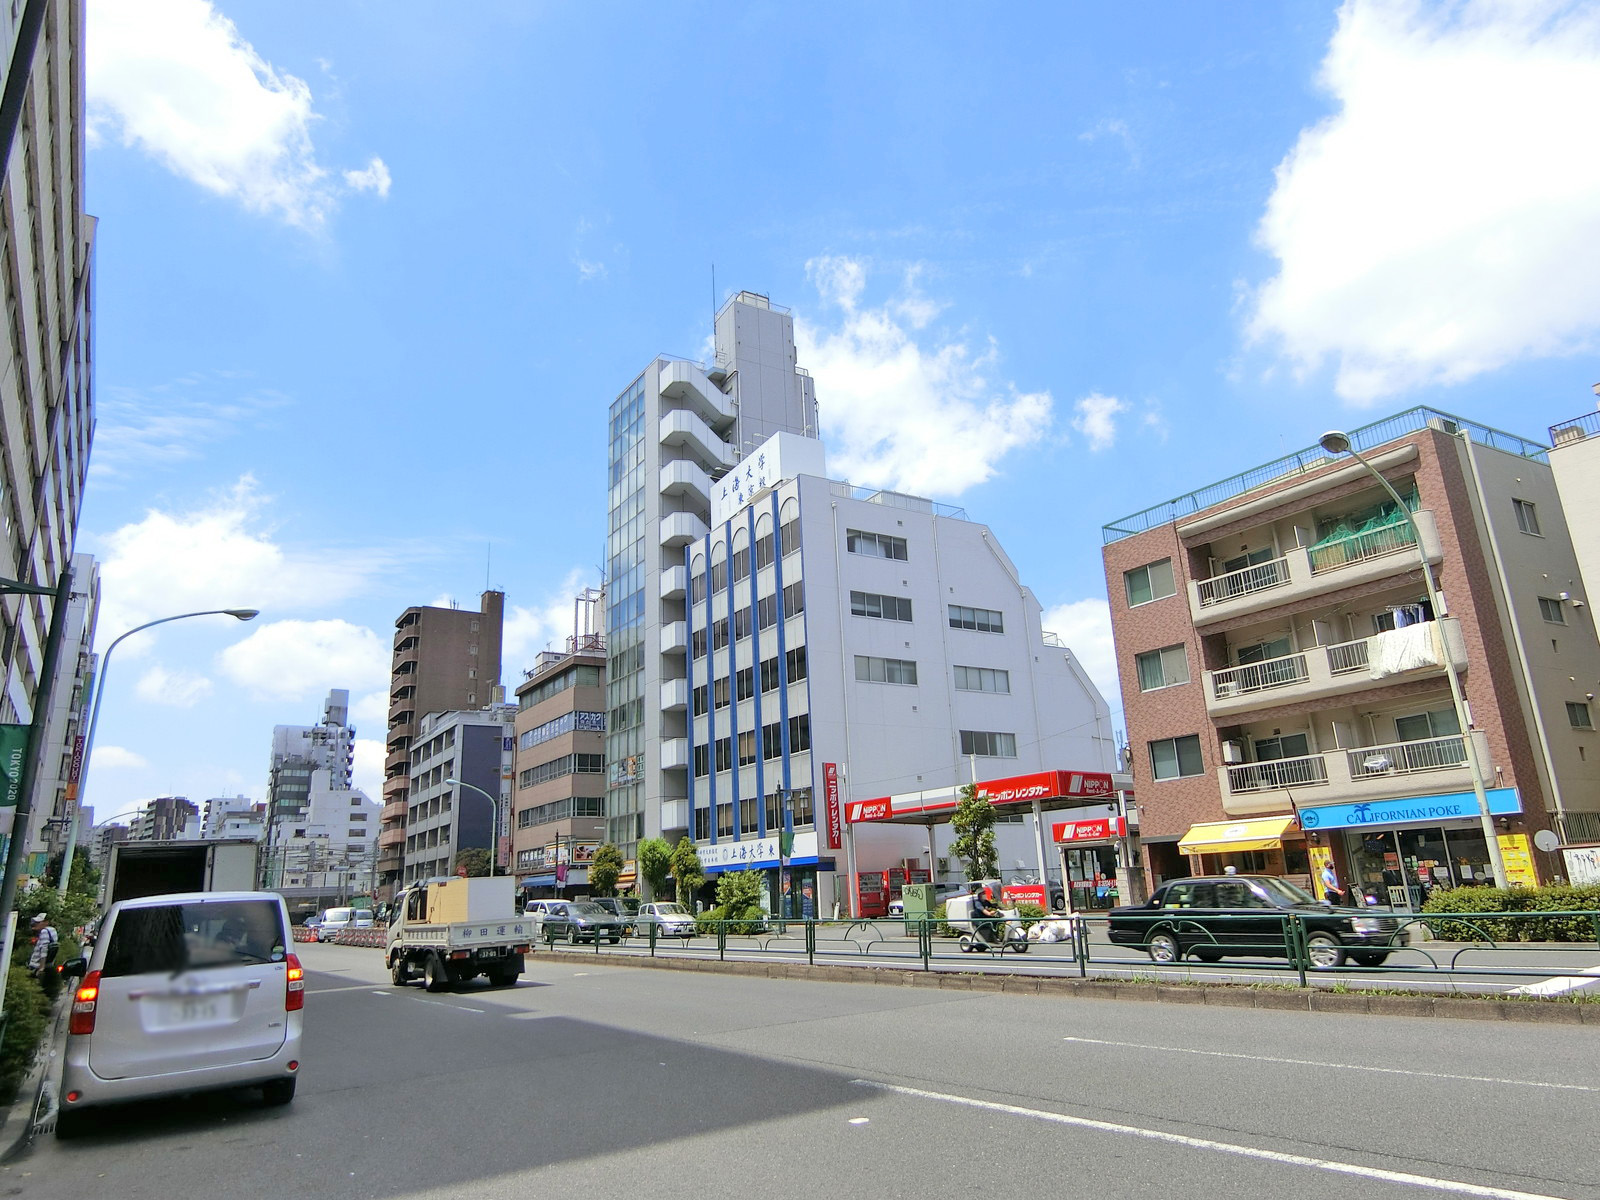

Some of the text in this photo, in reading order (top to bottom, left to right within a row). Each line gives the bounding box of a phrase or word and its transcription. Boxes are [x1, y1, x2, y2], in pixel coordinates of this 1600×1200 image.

[7, 747, 23, 801] TOKYO 2020
[1084, 779, 1109, 789] NIPPON
[988, 785, 1050, 802] ニッポンレンタカー
[863, 804, 887, 815] NIPPON
[1347, 805, 1461, 824] CALIFORNIAN POKE
[1076, 825, 1103, 834] NIPPON
[463, 925, 523, 938] 柳田運輸
